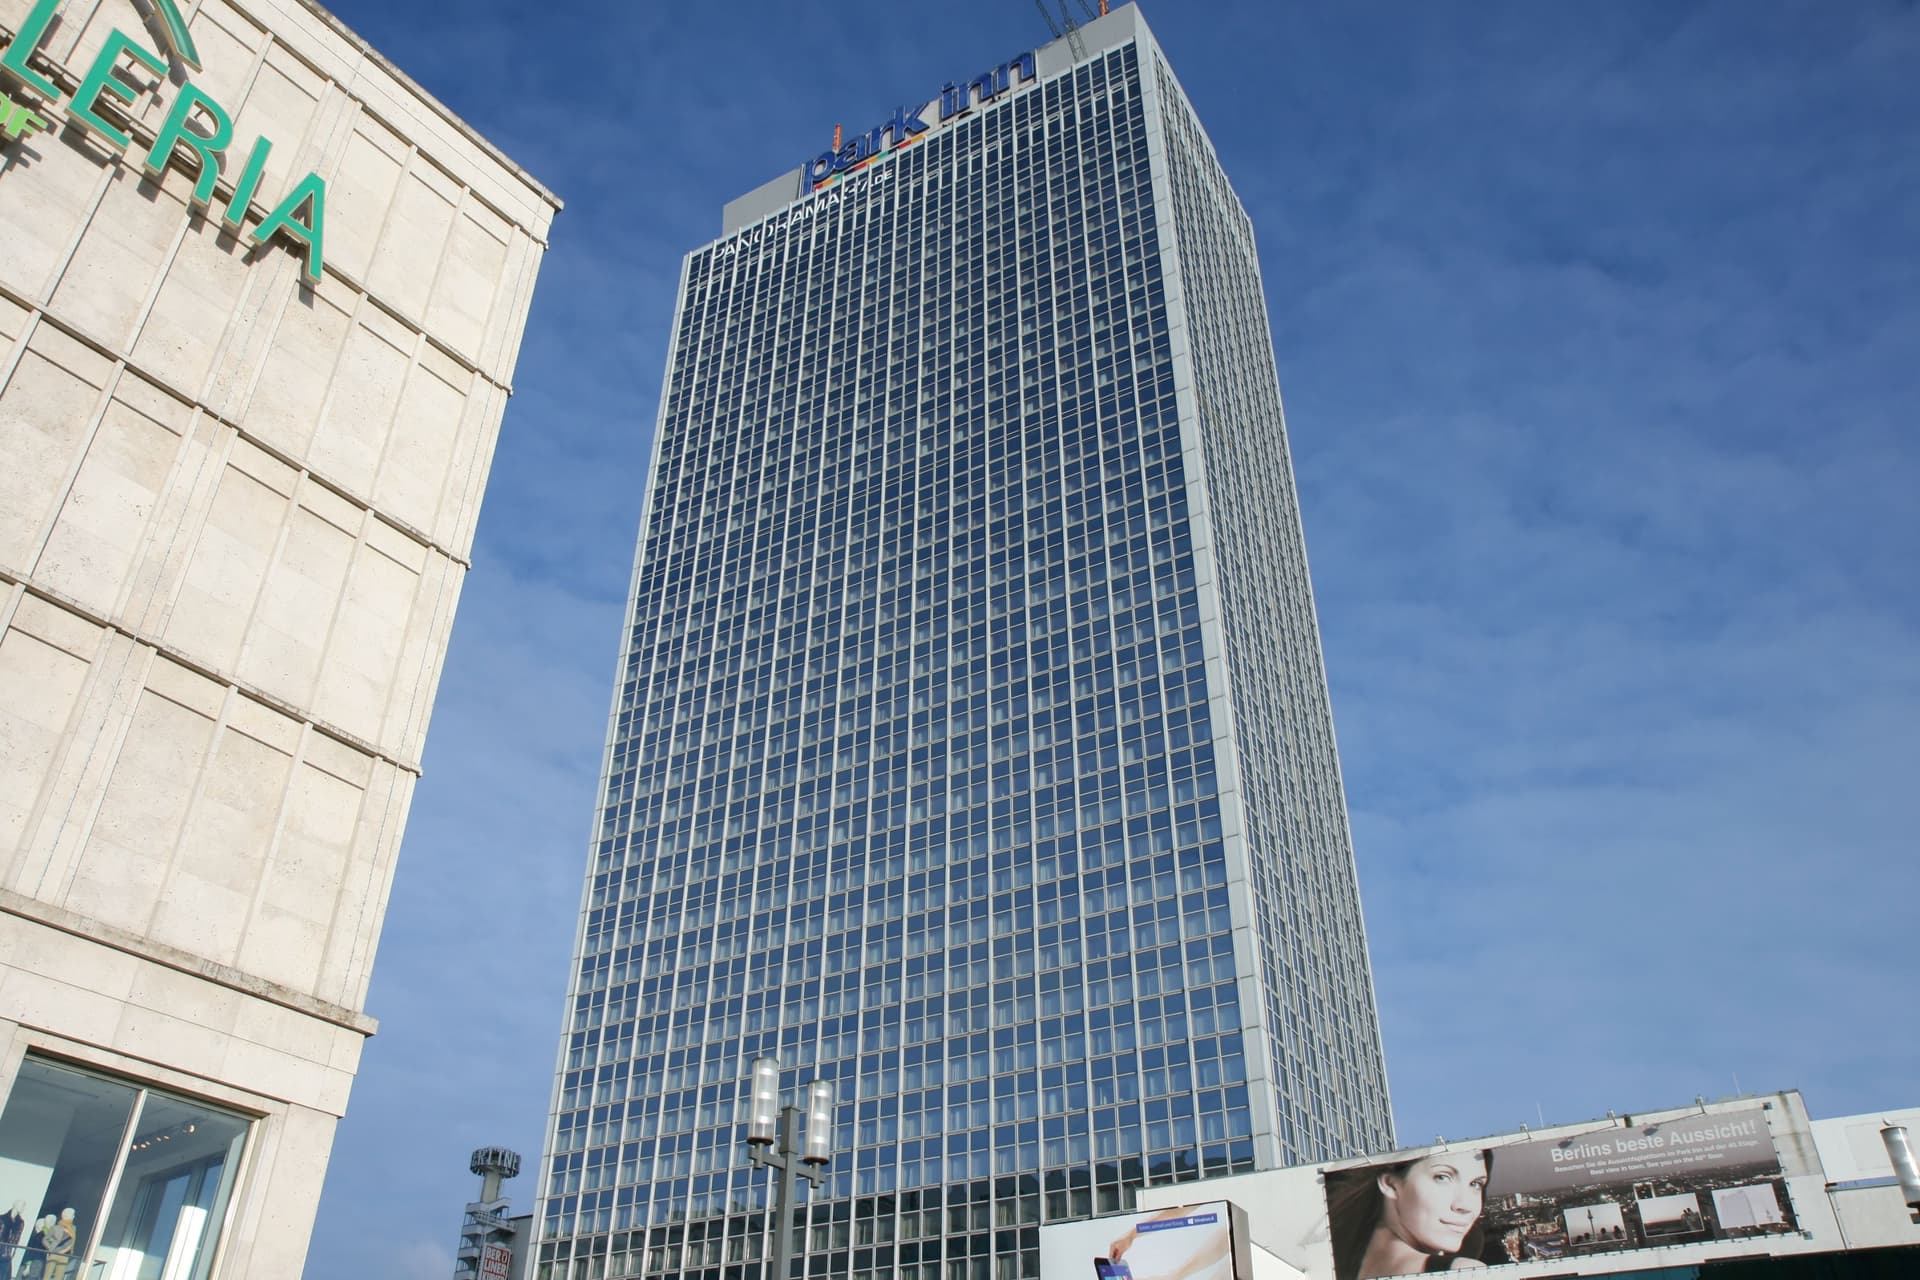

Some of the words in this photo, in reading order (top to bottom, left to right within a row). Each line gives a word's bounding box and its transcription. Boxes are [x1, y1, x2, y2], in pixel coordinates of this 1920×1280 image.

[801, 100, 930, 197] park
[941, 52, 1036, 121] inn
[1551, 1143, 1612, 1162] Berlins
[1616, 1135, 1665, 1153] beste
[1670, 1119, 1758, 1146] Aussicht!
